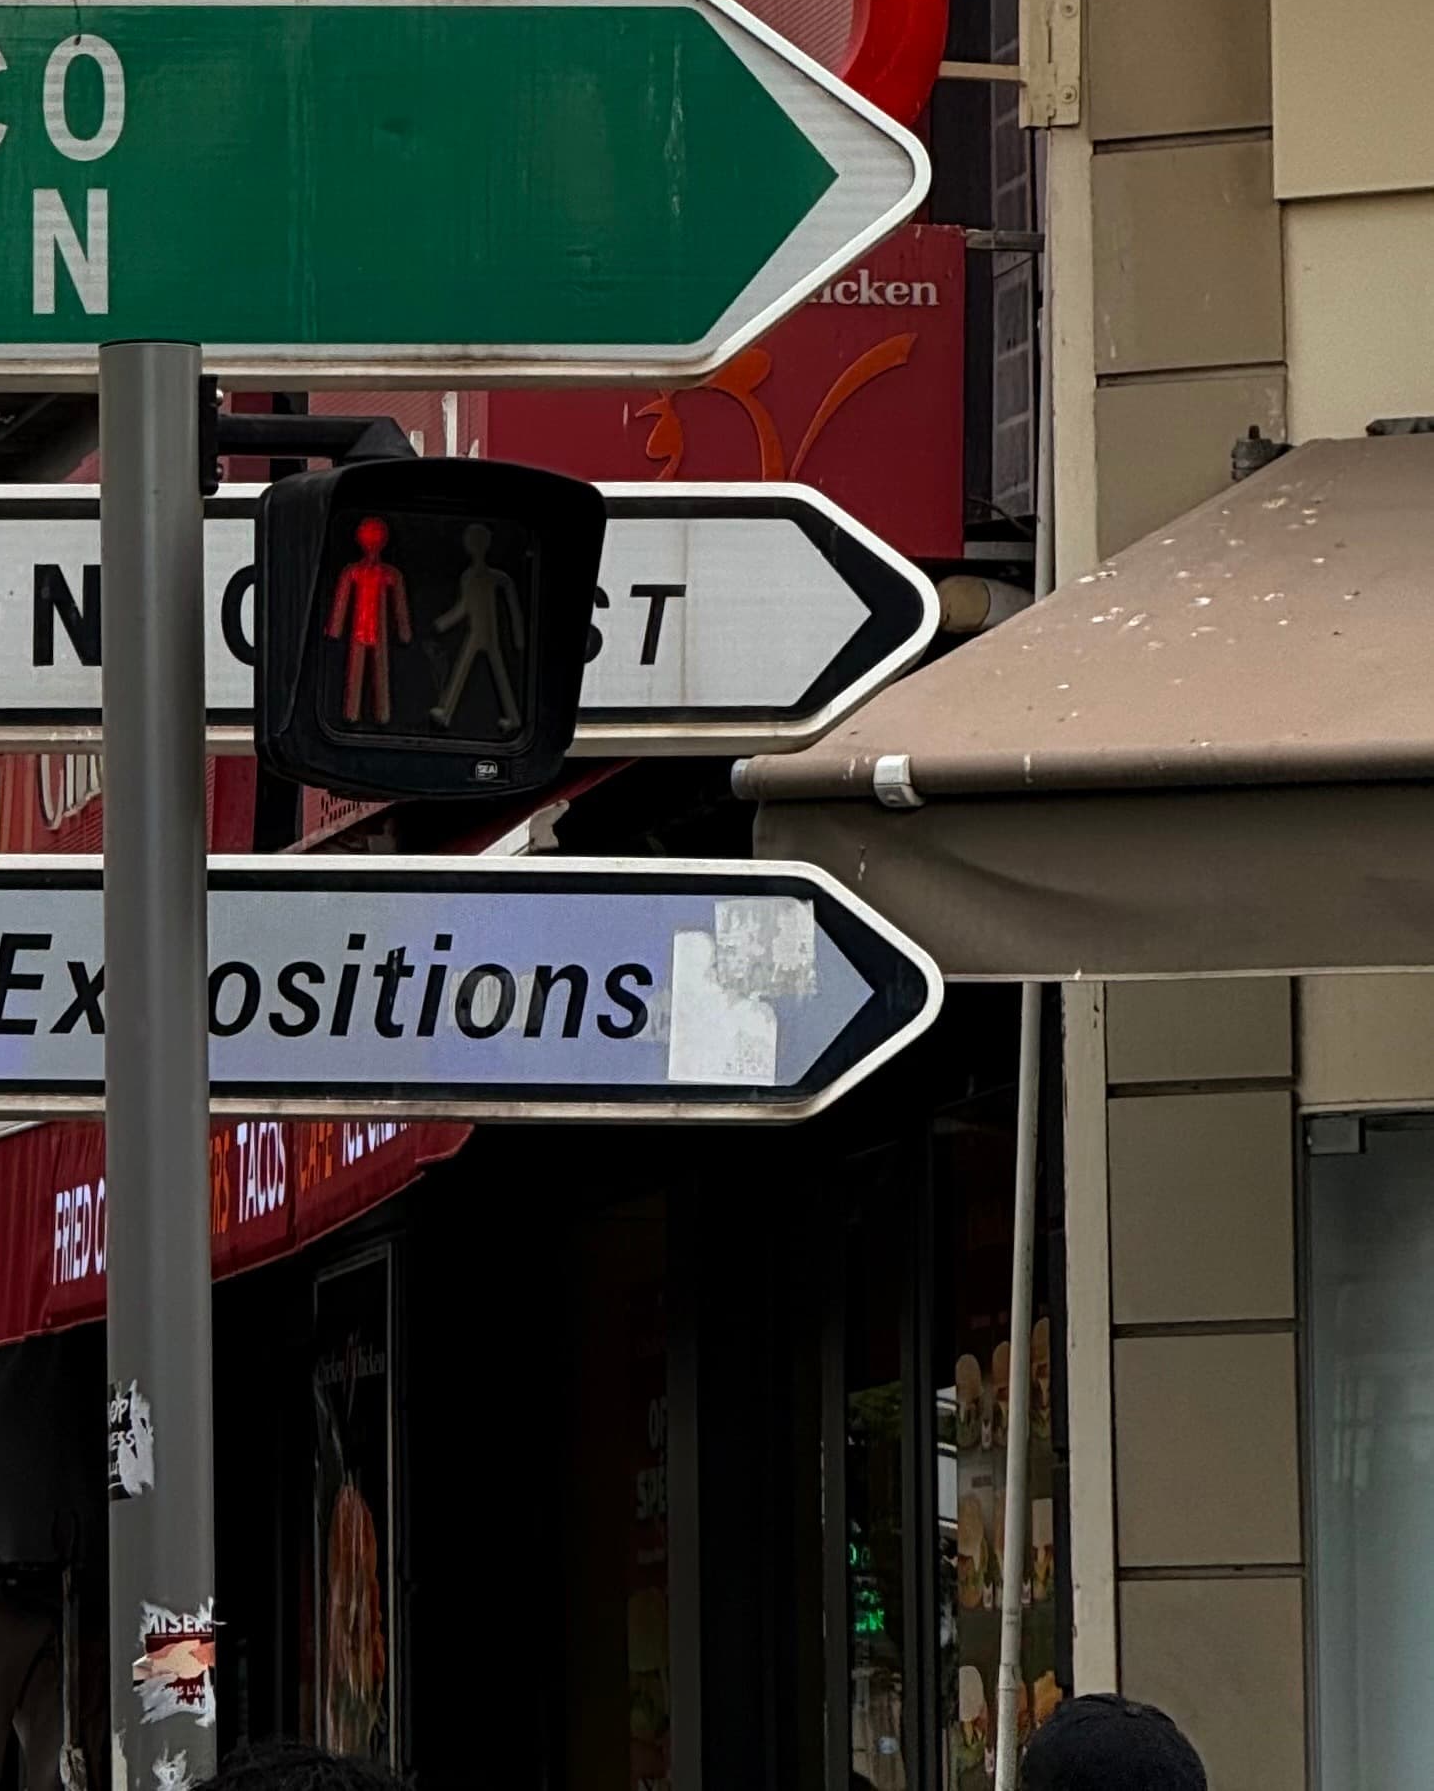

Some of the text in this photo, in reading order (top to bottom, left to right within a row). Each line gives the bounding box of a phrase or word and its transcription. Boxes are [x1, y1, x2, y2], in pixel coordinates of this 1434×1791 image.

[803, 269, 940, 307] icken
[237, 1121, 287, 1224] TACOS
[53, 1183, 91, 1286] FRIED
